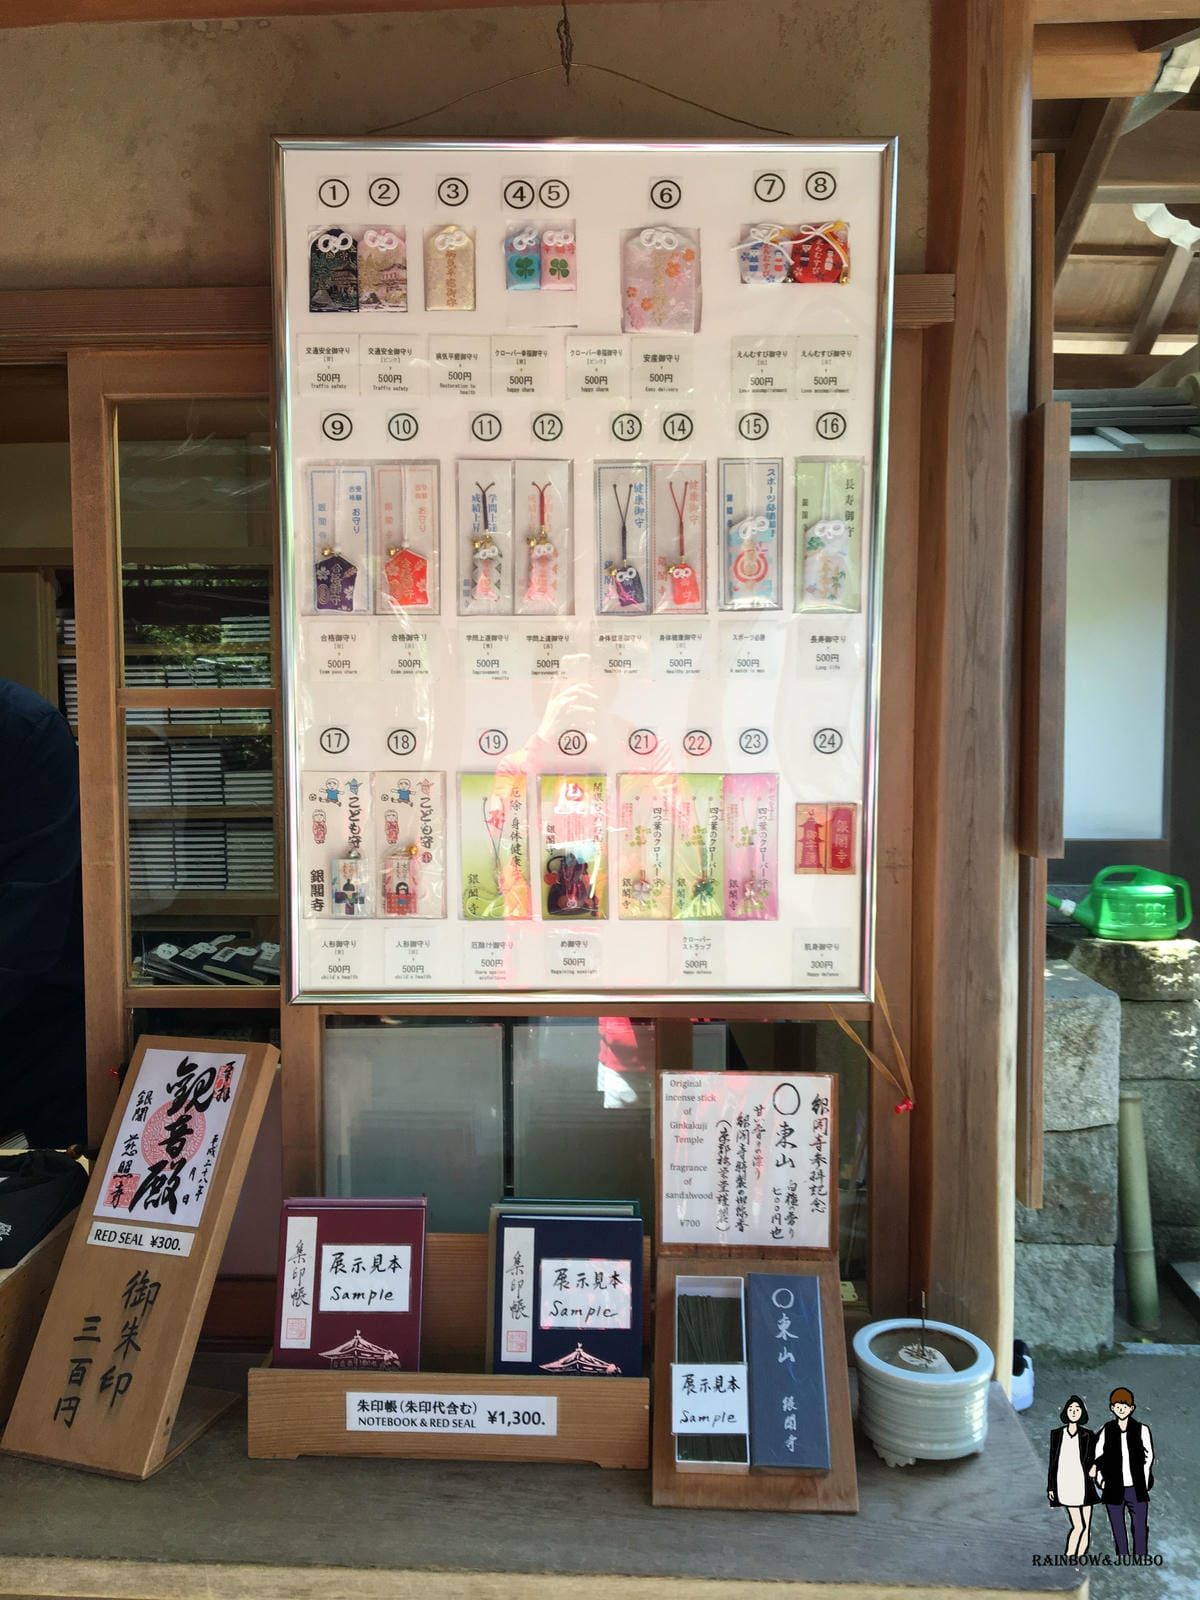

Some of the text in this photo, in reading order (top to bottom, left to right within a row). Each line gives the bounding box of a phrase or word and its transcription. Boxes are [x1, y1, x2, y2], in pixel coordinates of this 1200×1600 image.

[317, 373, 340, 382] 500円
[378, 374, 402, 383] 500円
[448, 372, 471, 381] 500円
[510, 376, 532, 385] 500円
[585, 376, 608, 385] 500円
[650, 374, 672, 382] 500円
[814, 376, 837, 385] 500円
[750, 377, 773, 386] 500円
[816, 654, 839, 662] 500円
[328, 660, 350, 668] 500円
[398, 660, 420, 668] 500円
[476, 660, 499, 668] 500円
[537, 660, 559, 668] 500円
[609, 660, 631, 668] 500円
[670, 659, 692, 667] 500円
[737, 659, 759, 667] 500円
[563, 958, 585, 966] 500円
[685, 960, 707, 968] 500円
[328, 965, 350, 973] 500円
[402, 965, 424, 973] 500円
[670, 1080, 701, 1088] Original
[665, 1094, 716, 1102] incense stick
[670, 1122, 708, 1130] Ginkakuji
[675, 1136, 704, 1145] Temple
[670, 1164, 707, 1172] fragrance
[665, 1192, 713, 1200] sandalwood
[680, 1219, 700, 1227] ¥700
[94, 1229, 181, 1250] RED SEAL ¥300.
[330, 1252, 403, 1274] 展示見本
[553, 1268, 623, 1290] 展示見本
[330, 1286, 394, 1305] Sample
[550, 1300, 618, 1322] Sample
[100, 1269, 162, 1408] 御朱印
[53, 1316, 101, 1429] 三百円
[682, 1374, 741, 1396] 展示見本
[487, 1411, 545, 1427] ¥1,300.
[680, 1410, 737, 1427] Sample
[359, 1418, 476, 1428] NOTEBOOK & RED SEAL
